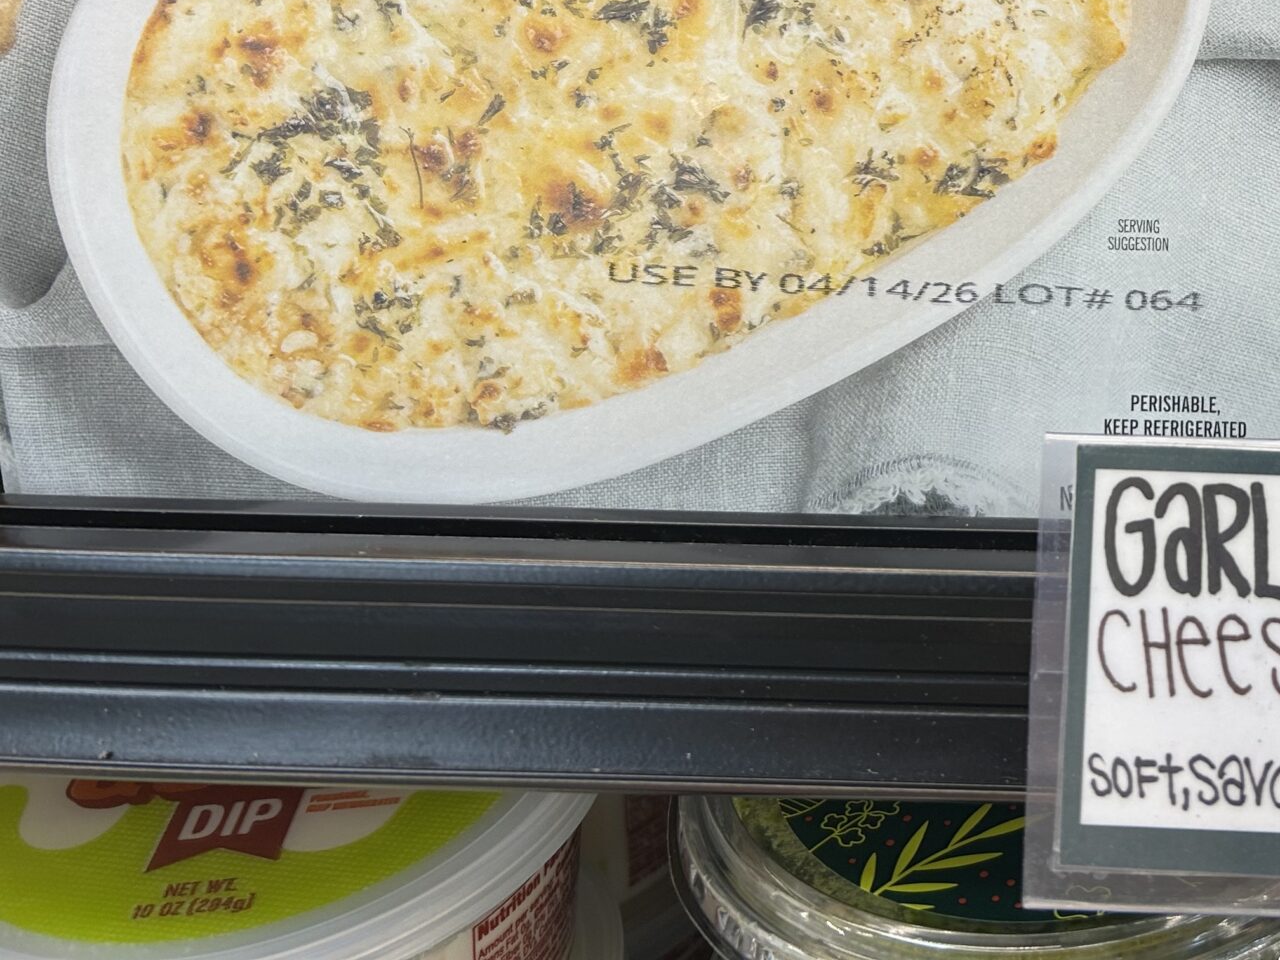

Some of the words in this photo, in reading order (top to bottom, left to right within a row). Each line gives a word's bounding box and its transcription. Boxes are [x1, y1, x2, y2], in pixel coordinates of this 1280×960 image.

[1117, 218, 1161, 234] SERVING
[1107, 236, 1170, 252] SUGGESTION
[608, 261, 698, 287] USE
[714, 266, 767, 292] BY
[778, 271, 978, 304] 04/14/26
[993, 282, 1113, 309] LOT#
[1124, 289, 1204, 312] 064
[1130, 394, 1221, 416] PERISHABLE,
[1103, 418, 1139, 436] KEEP
[1143, 419, 1247, 438] REFRIGERATED
[177, 797, 283, 841] DIP
[163, 880, 202, 898] NET
[132, 903, 155, 920] 10
[478, 872, 542, 941] Nutrition
